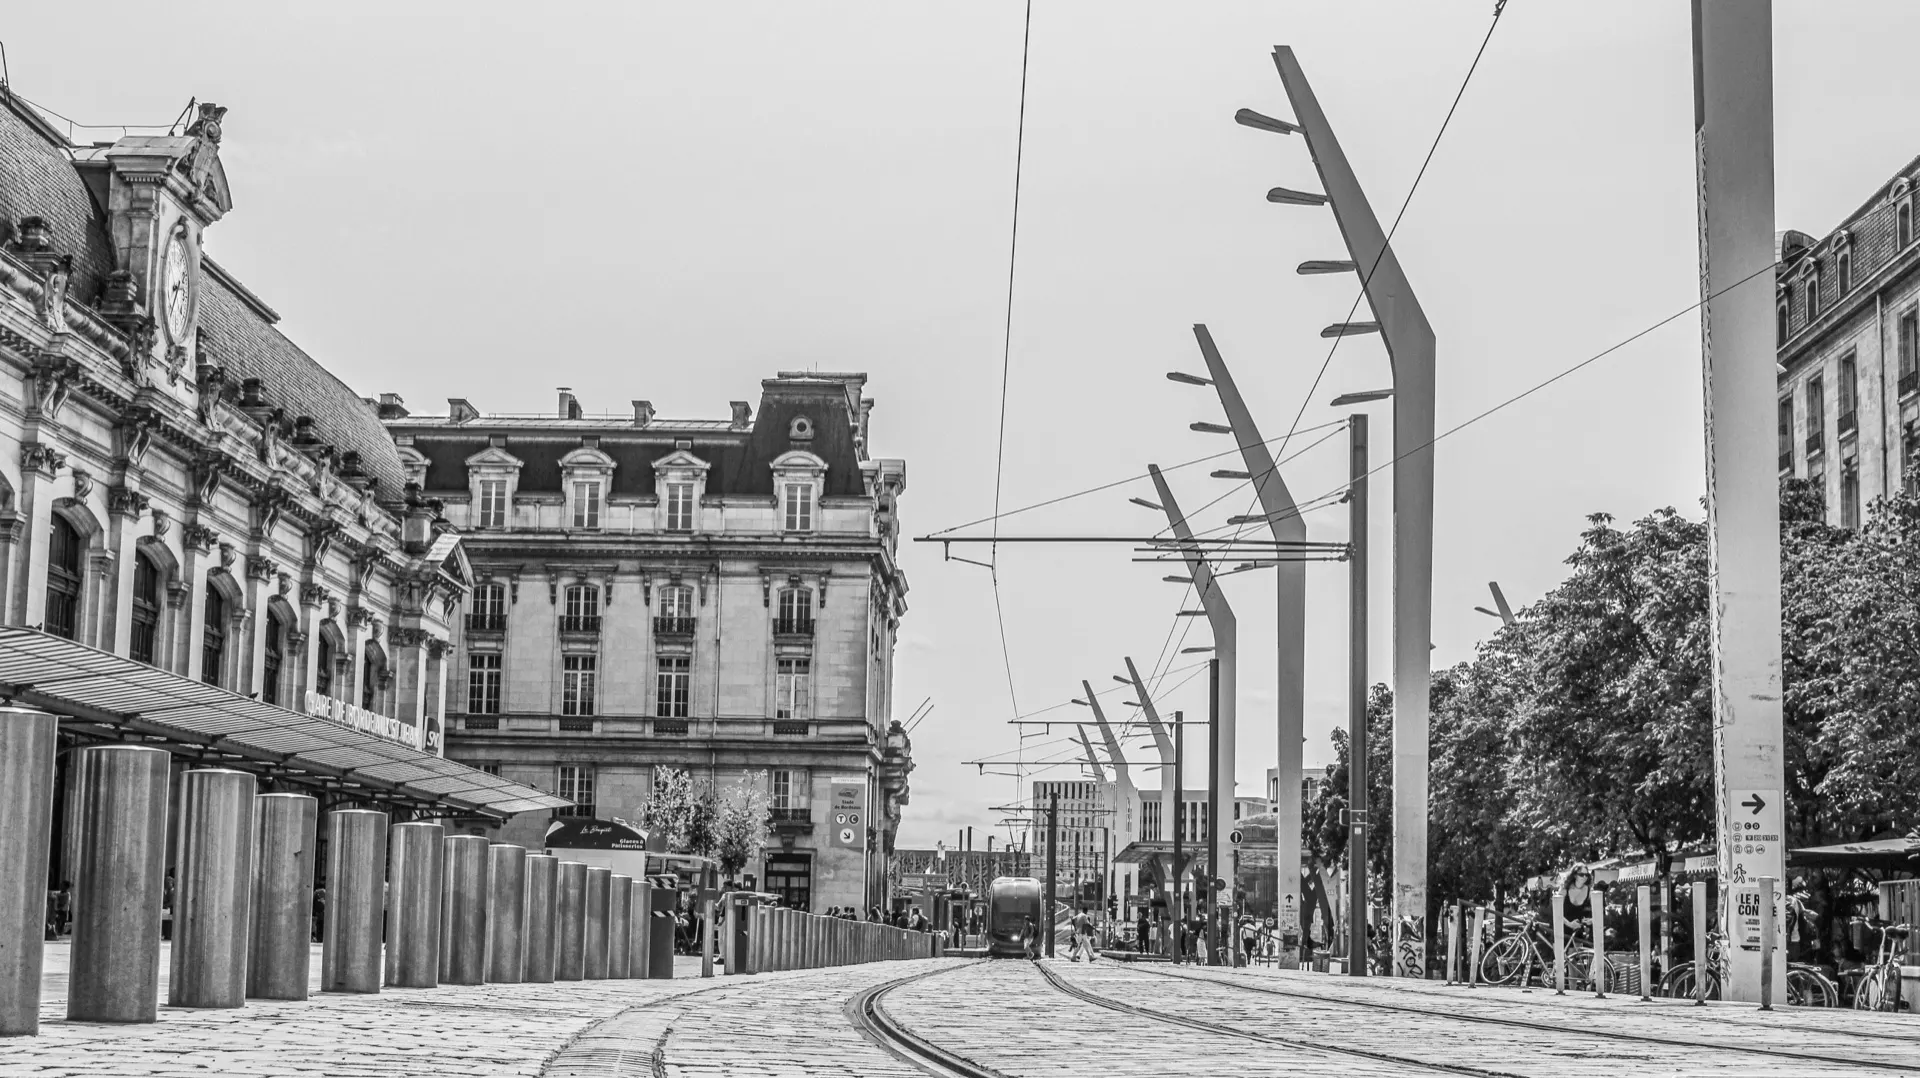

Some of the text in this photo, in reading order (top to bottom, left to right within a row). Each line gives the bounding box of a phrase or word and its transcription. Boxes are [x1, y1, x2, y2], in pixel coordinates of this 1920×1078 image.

[304, 690, 332, 718] GARE
[335, 699, 346, 723] DE
[346, 703, 390, 738] BORDEAUX
[1740, 893, 1752, 905] LE
